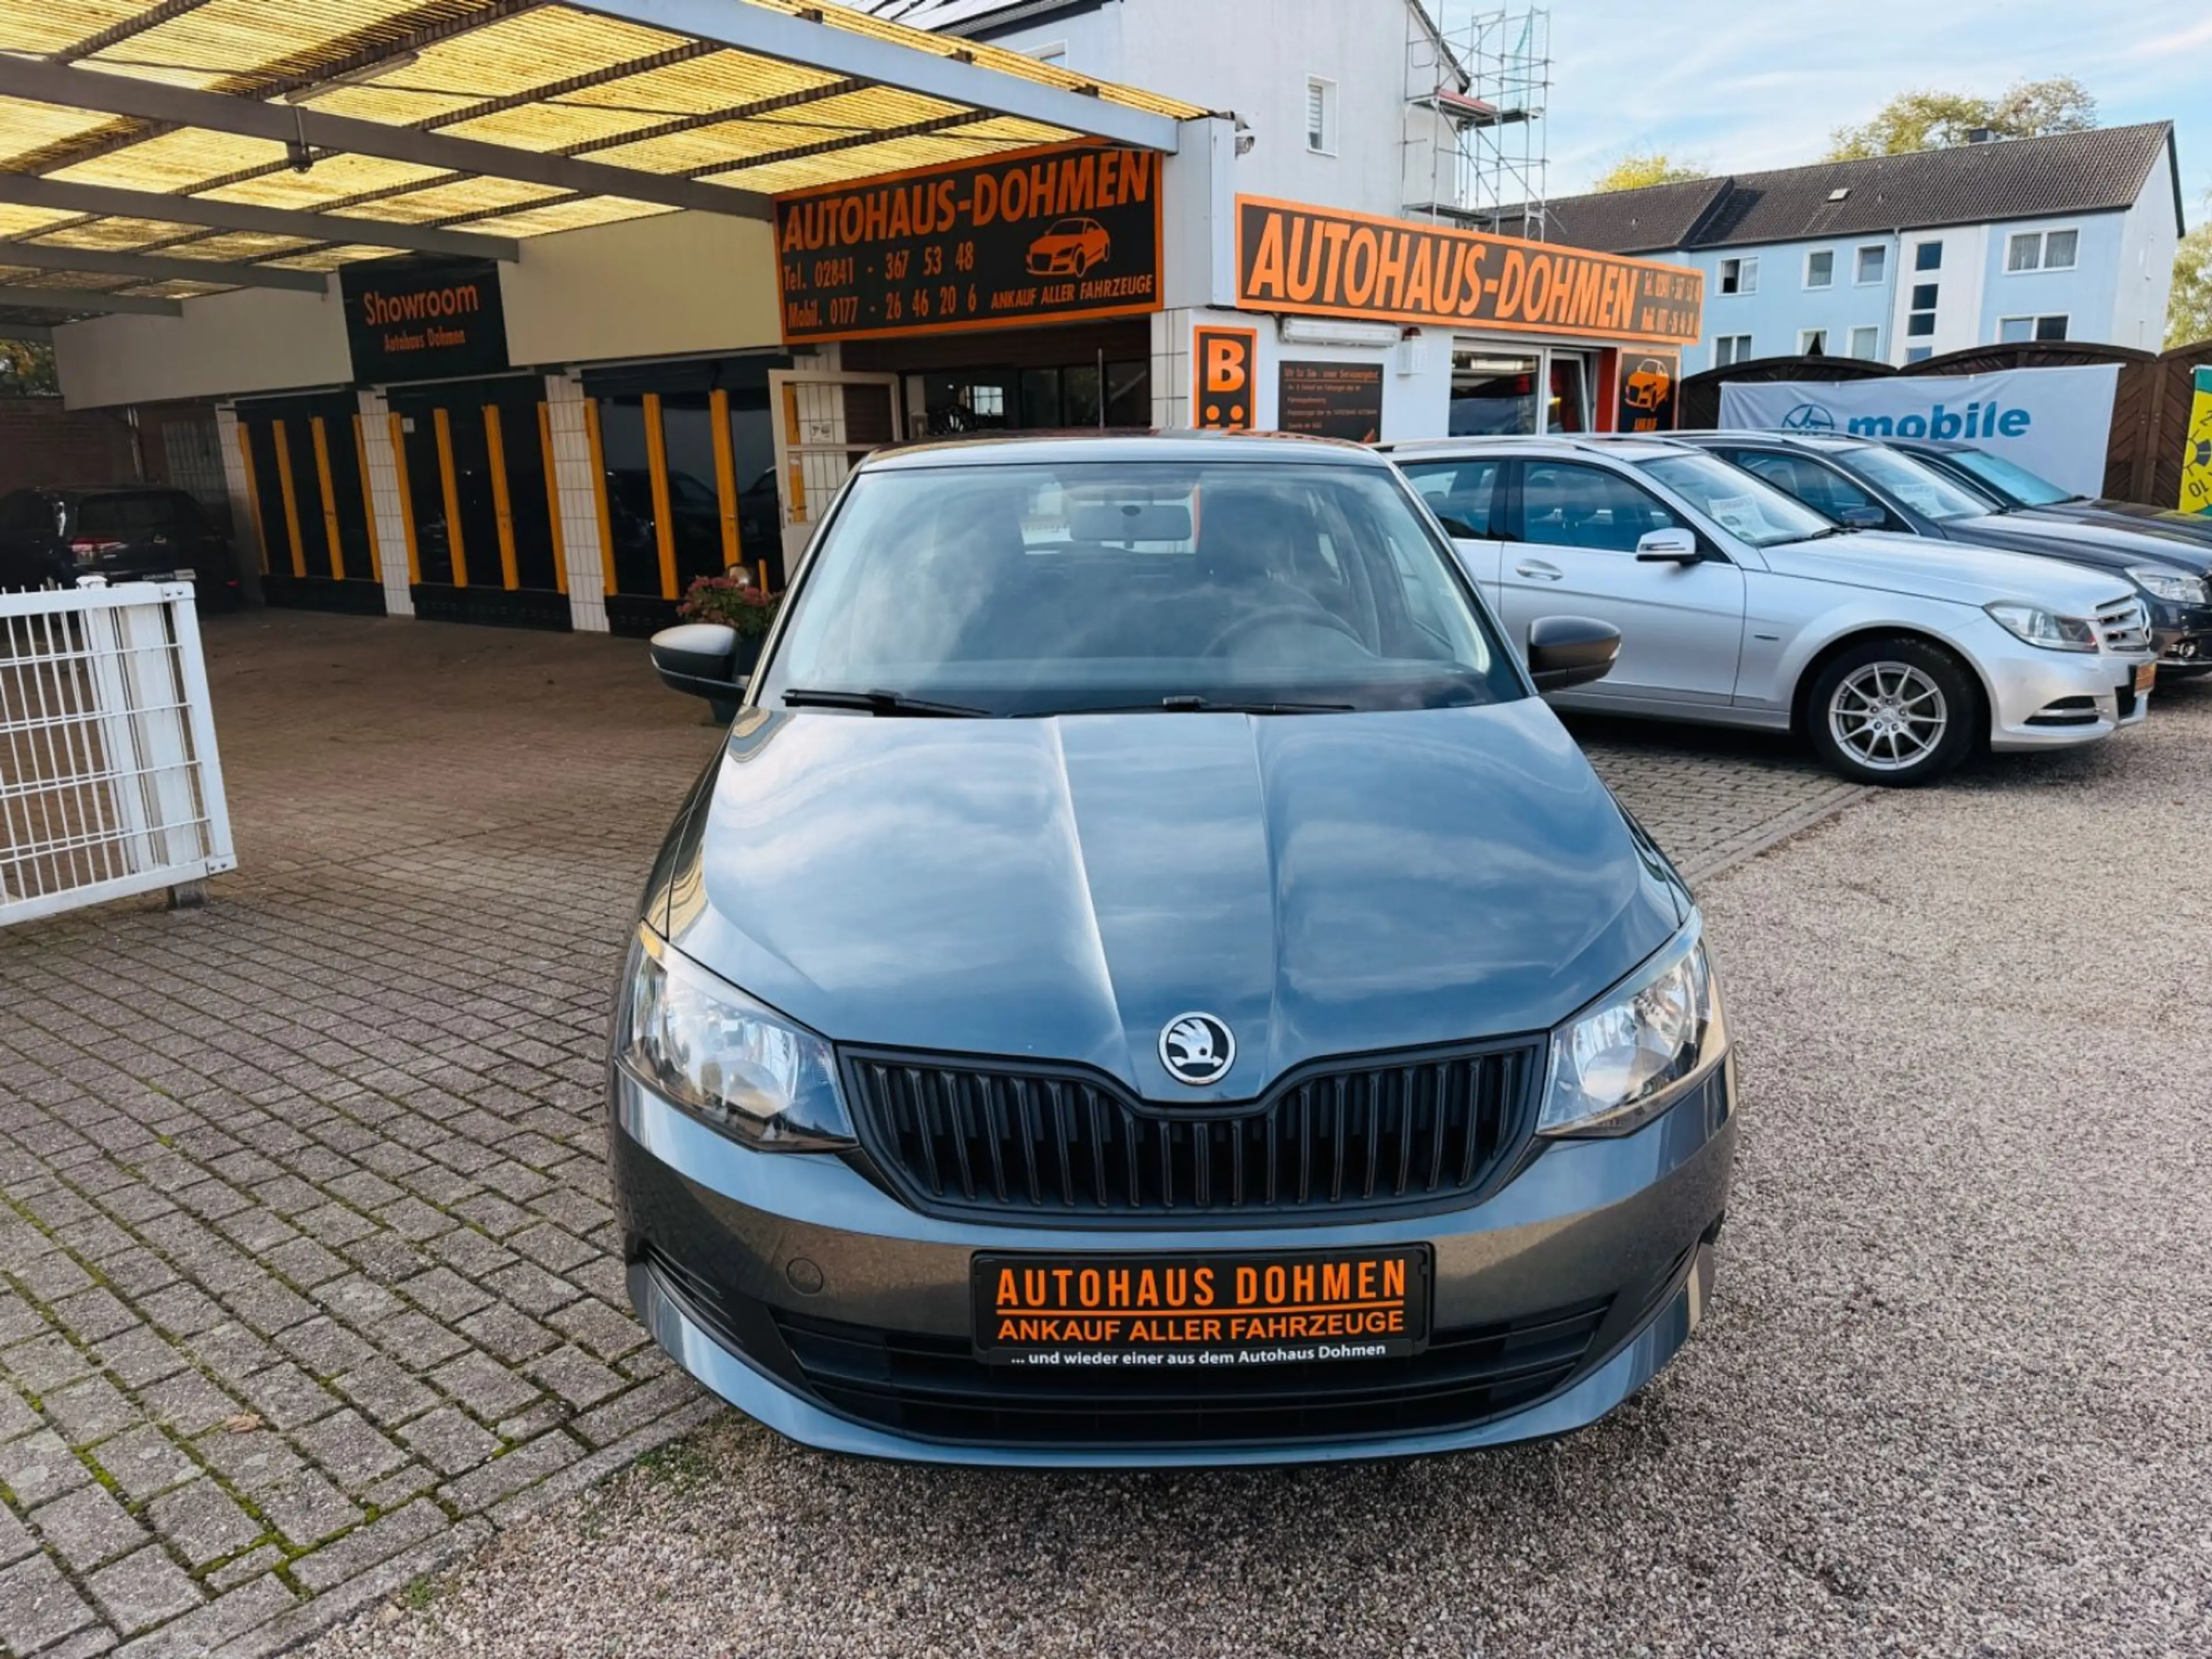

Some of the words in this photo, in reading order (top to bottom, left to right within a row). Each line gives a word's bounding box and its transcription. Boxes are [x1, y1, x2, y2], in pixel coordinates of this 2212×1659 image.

[782, 150, 1149, 252] AUTOHAUS-DOHMEN
[784, 262, 806, 290] Tel.
[815, 257, 854, 288] 02841
[885, 249, 910, 281] 367
[923, 245, 942, 276] 53
[955, 241, 975, 271] 48
[1247, 213, 1637, 329] AUTOHAUS-DOHMEN
[363, 285, 479, 326] Showroom
[830, 296, 859, 324] 0177
[885, 291, 902, 320] 26
[912, 289, 929, 317] 46
[940, 286, 957, 315] 20
[968, 283, 977, 313] 6
[991, 287, 1037, 310] ANKAUF
[1040, 283, 1075, 305] ALLER
[1080, 274, 1153, 300] FAHRZEUGE
[1848, 401, 2031, 440] mobile
[995, 1267, 1215, 1306] AUTOHAUS
[1236, 1259, 1404, 1304] DOHMEN
[997, 1319, 1121, 1341] ANKAUF
[1128, 1319, 1222, 1341] ALLER
[1230, 1310, 1404, 1340] FAHRZEUGE
[1028, 1351, 1060, 1365] und
[1064, 1351, 1119, 1365] wieder
[1122, 1352, 1163, 1365] einer
[1166, 1354, 1196, 1364] aus
[1199, 1351, 1234, 1364] dem
[1238, 1347, 1315, 1363] Autohaus
[1319, 1344, 1386, 1359] Dohmen
